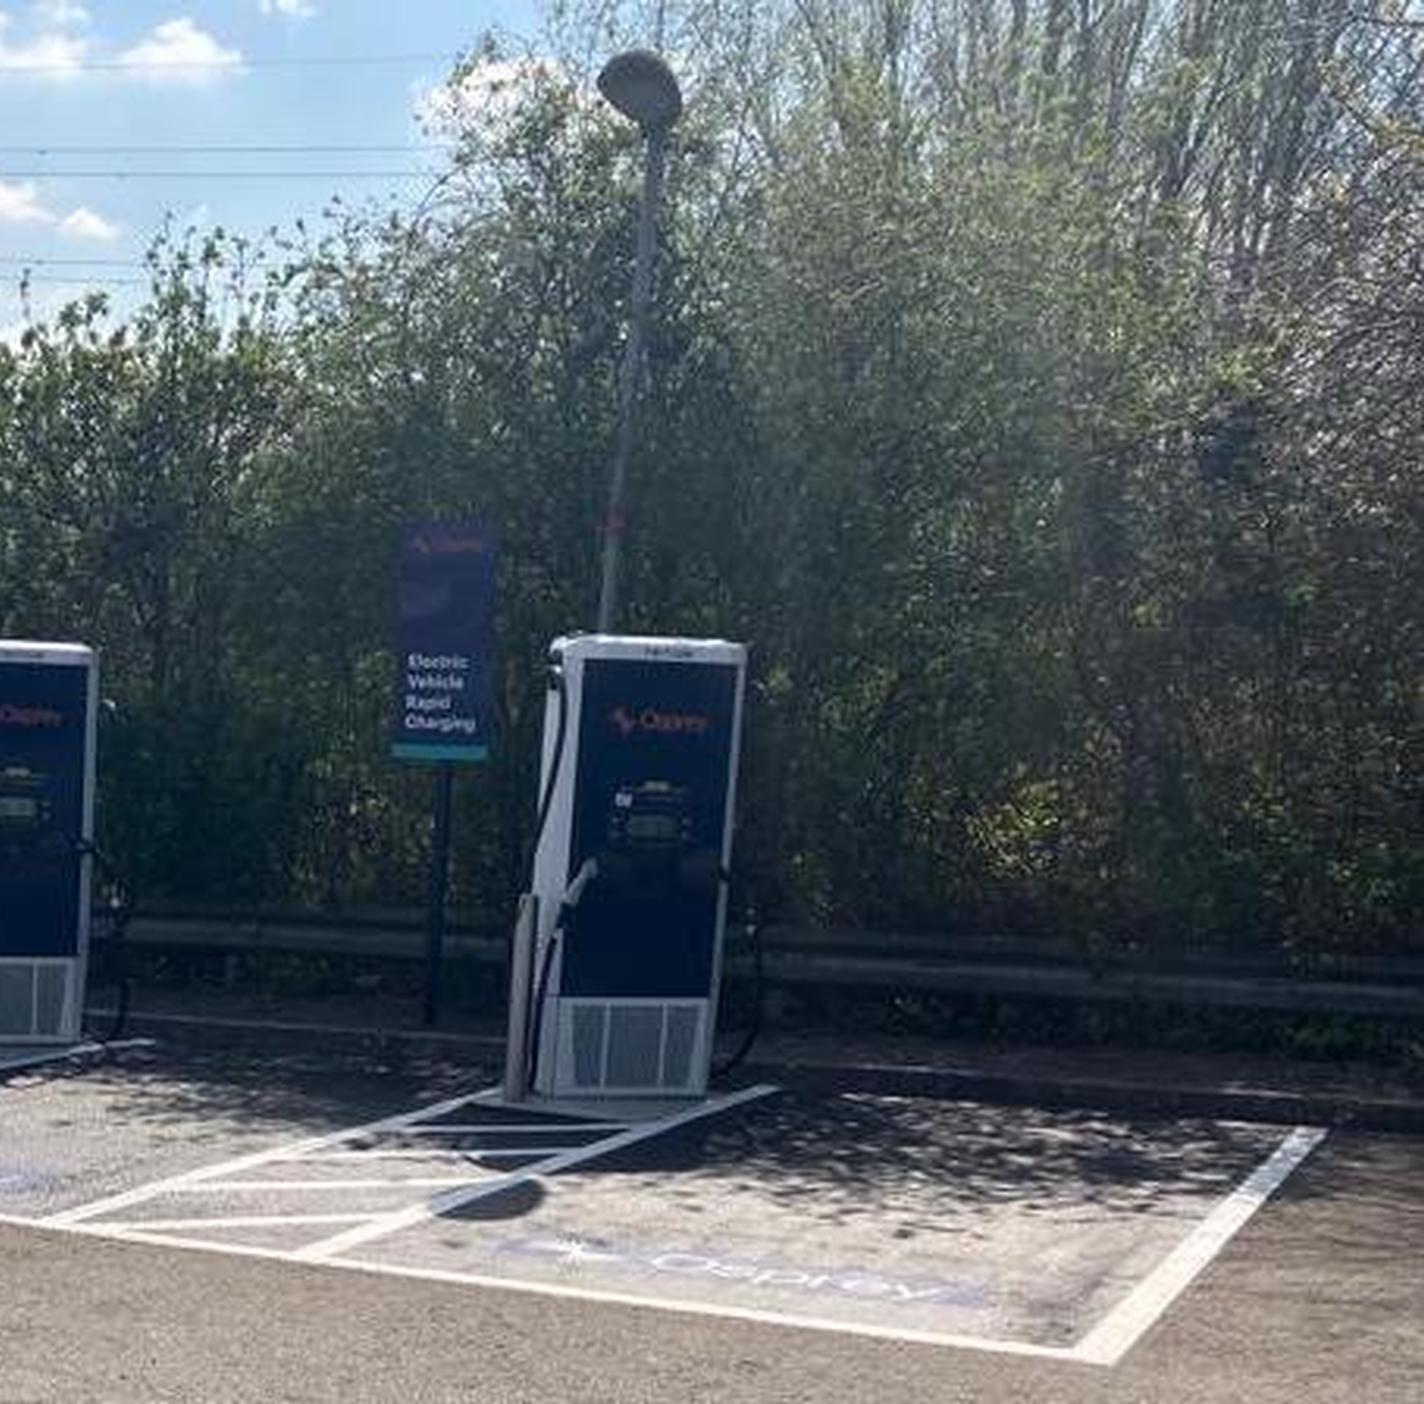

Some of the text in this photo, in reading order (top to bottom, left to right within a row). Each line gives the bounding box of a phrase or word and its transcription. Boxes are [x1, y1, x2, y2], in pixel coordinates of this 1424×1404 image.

[408, 653, 469, 669] Electric
[407, 673, 464, 690] Vehicle
[405, 694, 451, 714] Rapid
[404, 712, 476, 735] Charging
